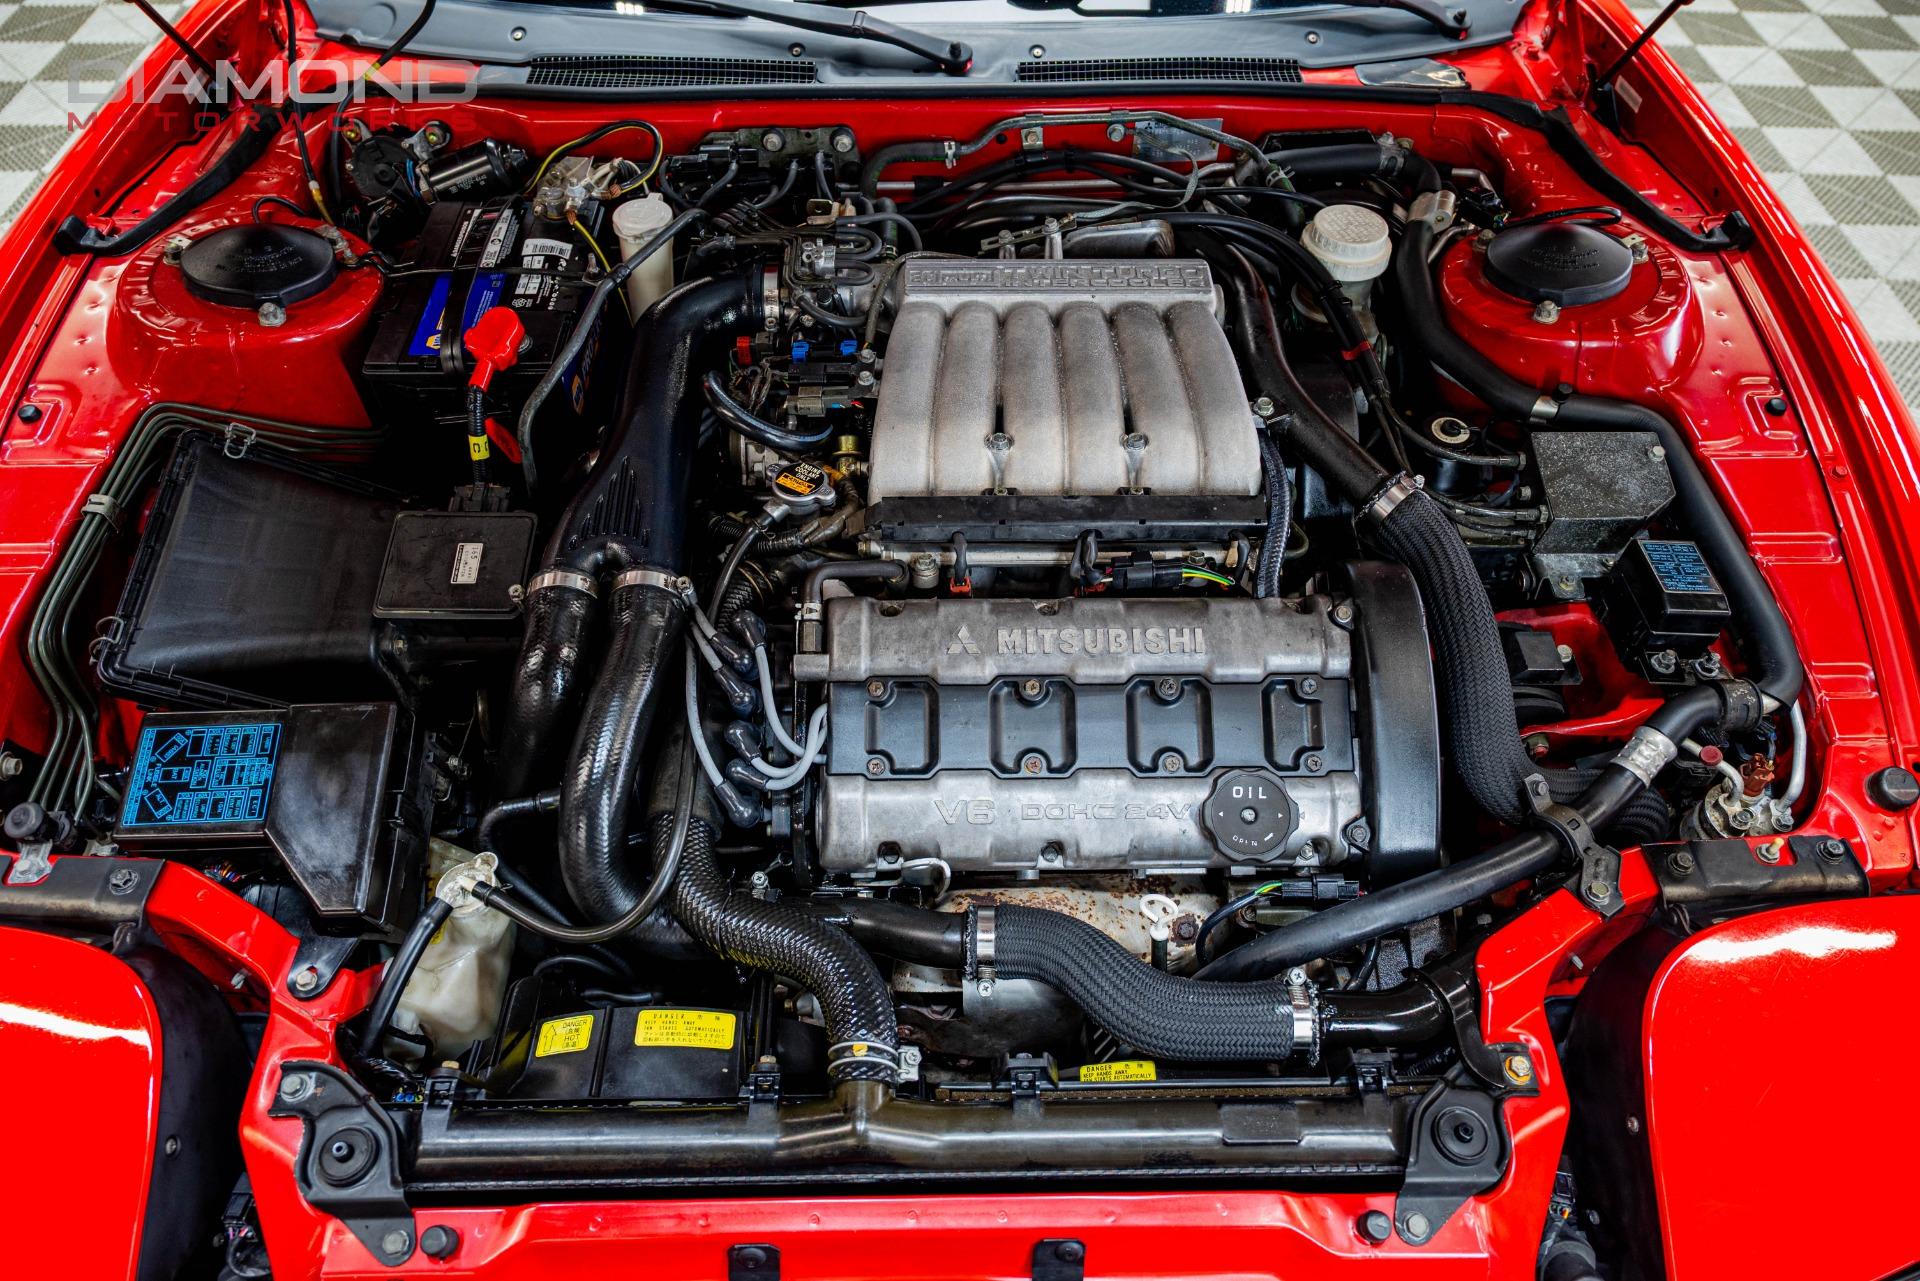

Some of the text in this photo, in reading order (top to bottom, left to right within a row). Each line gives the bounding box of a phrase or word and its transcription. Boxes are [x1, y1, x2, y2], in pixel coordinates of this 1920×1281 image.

[795, 466, 820, 480] COOLANT
[800, 462, 821, 475] ENGINE
[795, 472, 811, 482] ONLY
[997, 626, 1205, 655] MITSUBISHI
[1232, 786, 1267, 799] OIL
[934, 800, 1192, 825] V6 DOHC 24V
[562, 1019, 588, 1029] DANGER
[564, 1034, 581, 1042] HOT
